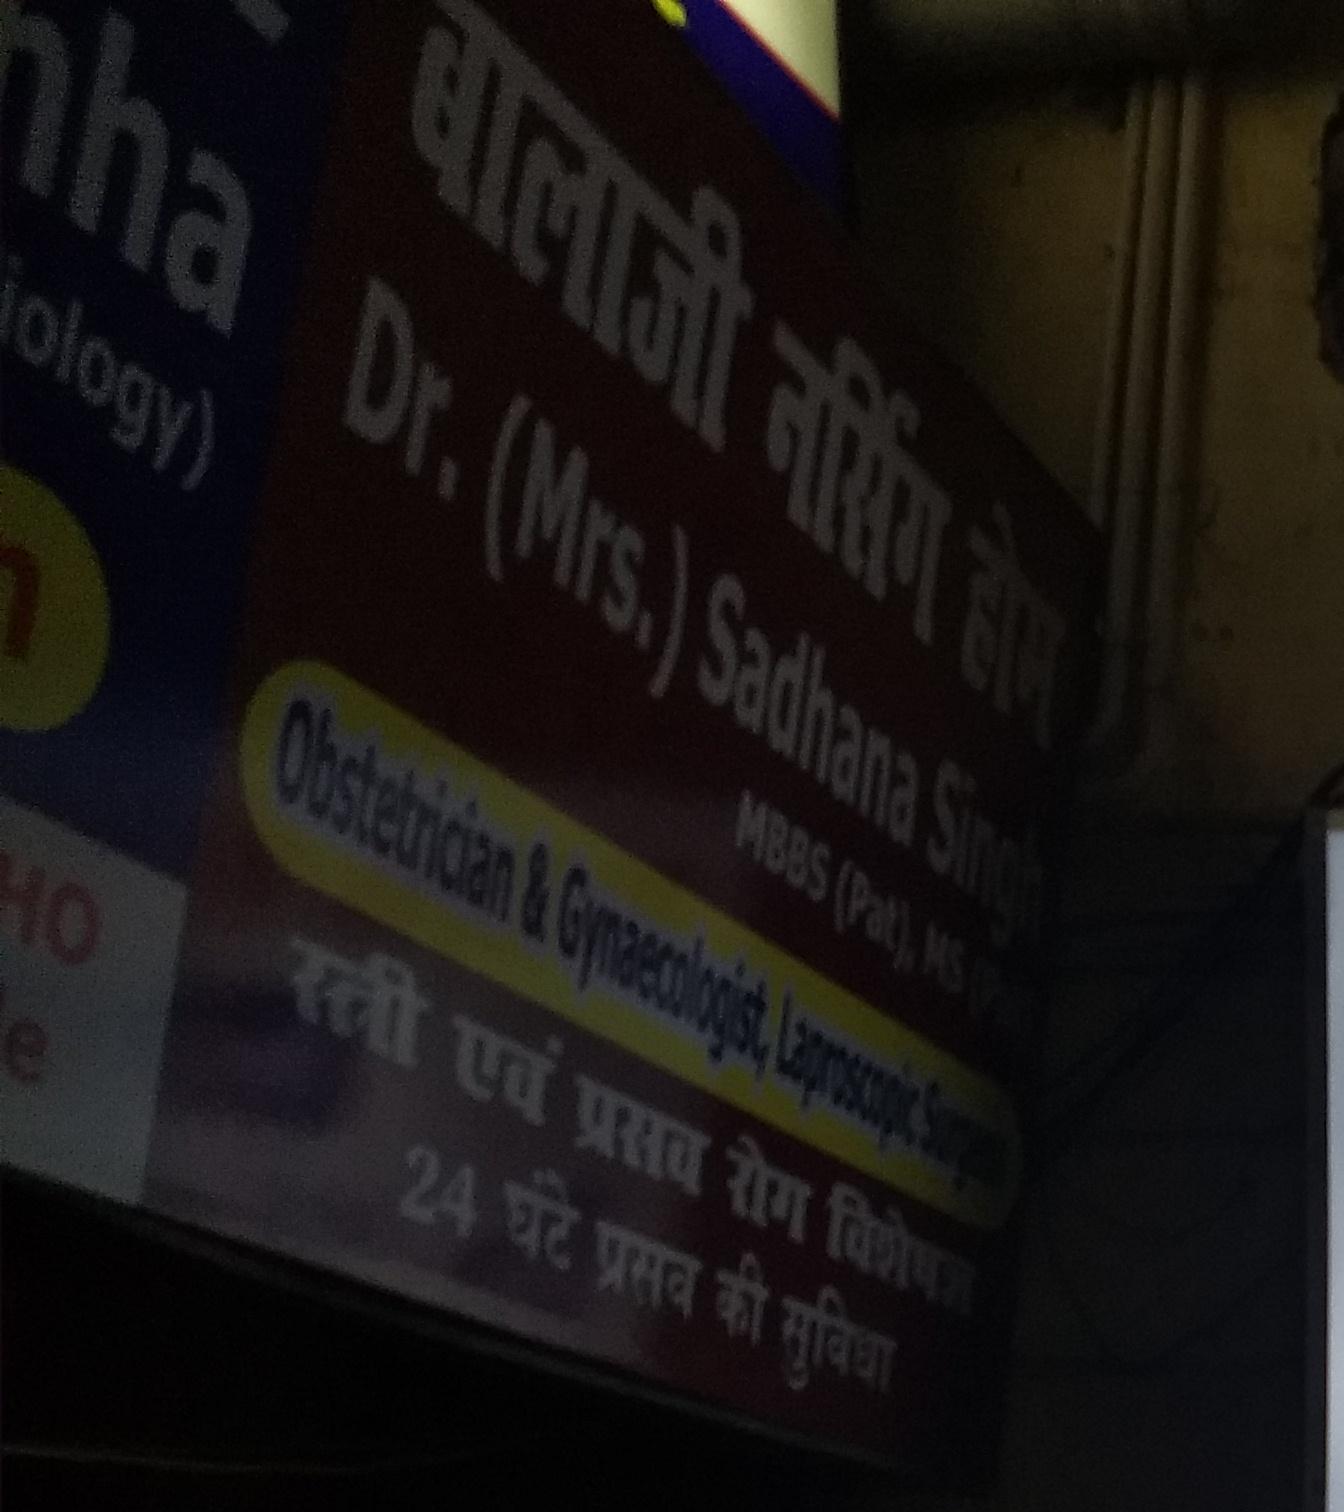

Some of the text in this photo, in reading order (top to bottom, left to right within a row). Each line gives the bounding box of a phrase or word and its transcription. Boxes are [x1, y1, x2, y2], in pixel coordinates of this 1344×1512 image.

[411, 0, 756, 453] बालाजी
[343, 274, 459, 502] Dr.
[484, 393, 689, 700] (Mrs.)
[698, 573, 920, 848] Sadhana
[277, 698, 516, 923] Obstetrician
[521, 842, 551, 943] &
[557, 866, 768, 1082] Gynaecologist,
[735, 790, 832, 900] MBBS
[400, 1144, 479, 1240] 24
[597, 1220, 703, 1323] प्रसव
[714, 1252, 771, 1347] की
[453, 1015, 566, 1128] एवं
[574, 1072, 713, 1197] प्रसव
[725, 1134, 815, 1246] रोग
